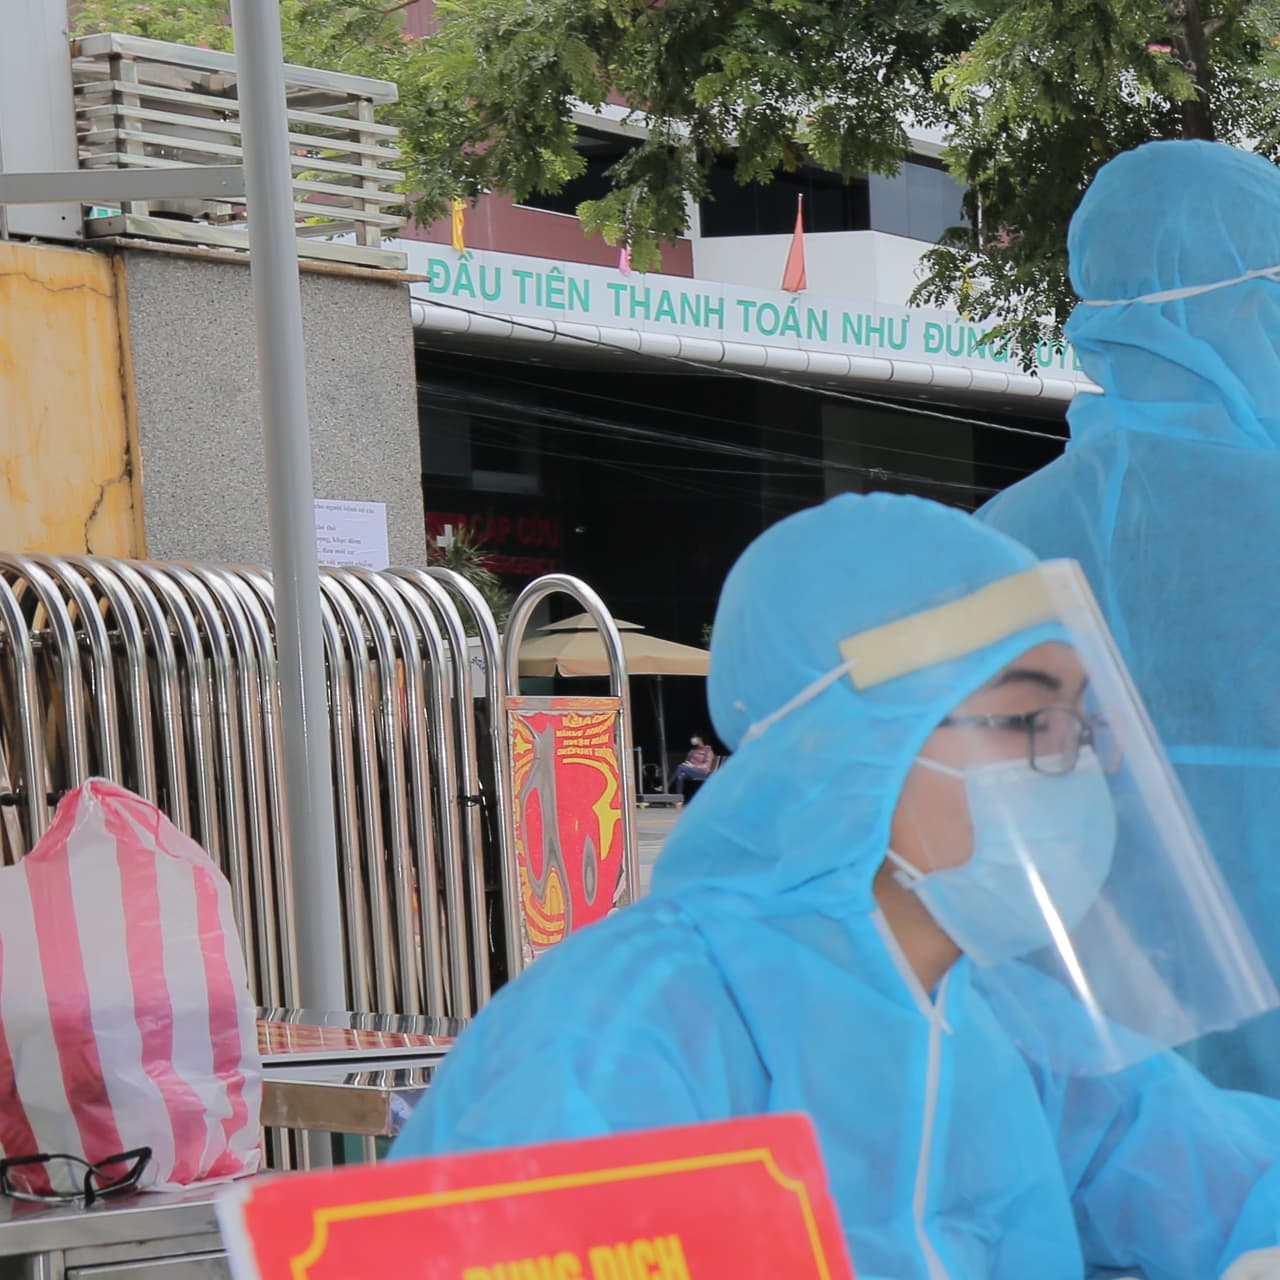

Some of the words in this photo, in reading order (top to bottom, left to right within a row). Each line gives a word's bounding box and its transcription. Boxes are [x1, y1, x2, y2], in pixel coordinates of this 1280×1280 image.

[427, 251, 501, 301] ĐẦU
[512, 266, 590, 313] TIÊN
[607, 282, 724, 330] THANH
[736, 298, 828, 342] TOÁN
[842, 312, 909, 350] NHƯ
